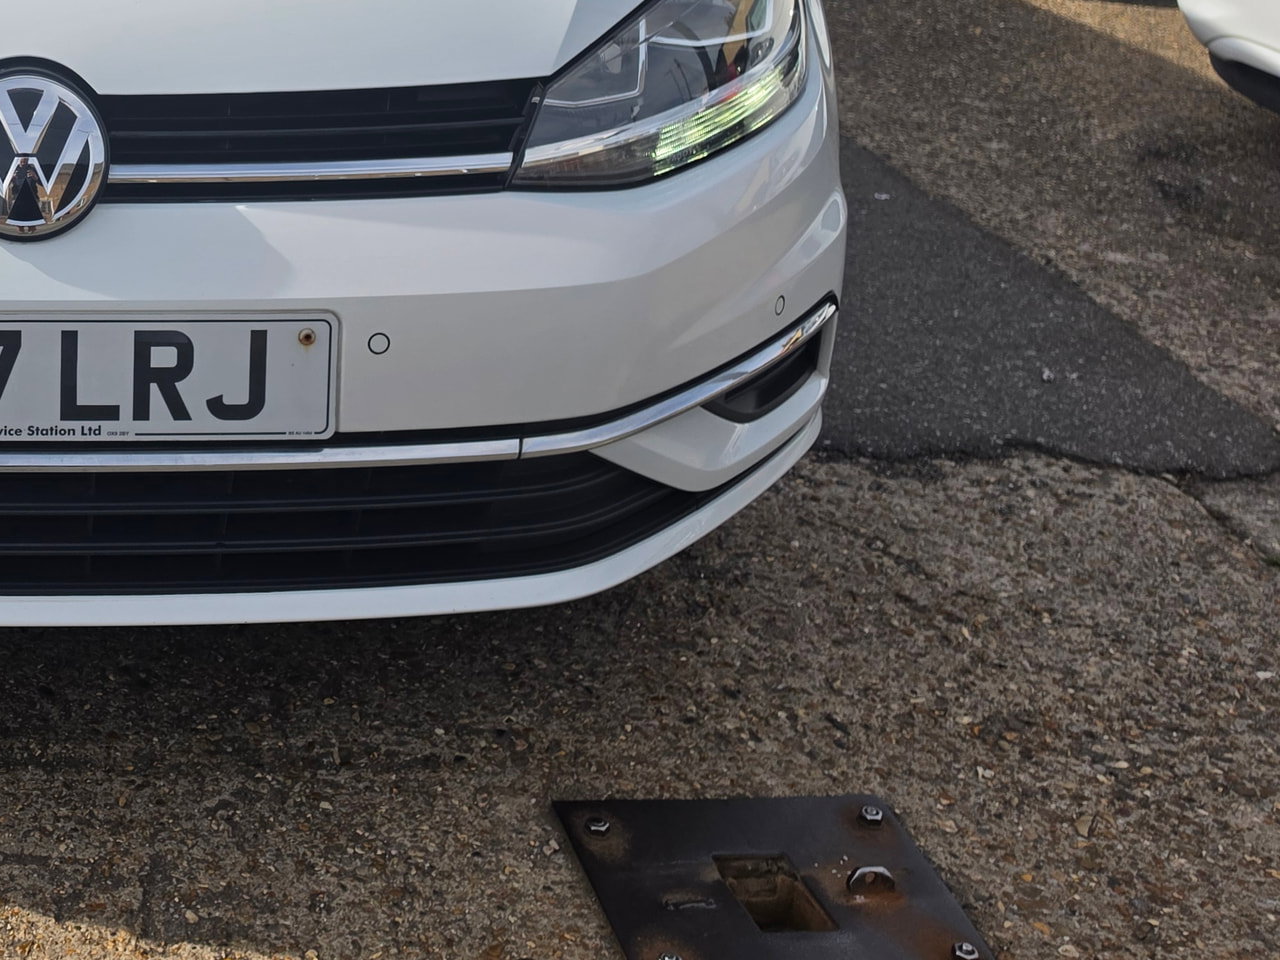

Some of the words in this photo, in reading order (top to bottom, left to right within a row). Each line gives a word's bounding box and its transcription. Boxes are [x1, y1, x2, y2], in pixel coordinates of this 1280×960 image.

[59, 329, 268, 422] LRJ
[27, 425, 76, 436] Station
[81, 425, 102, 436] Ltd
